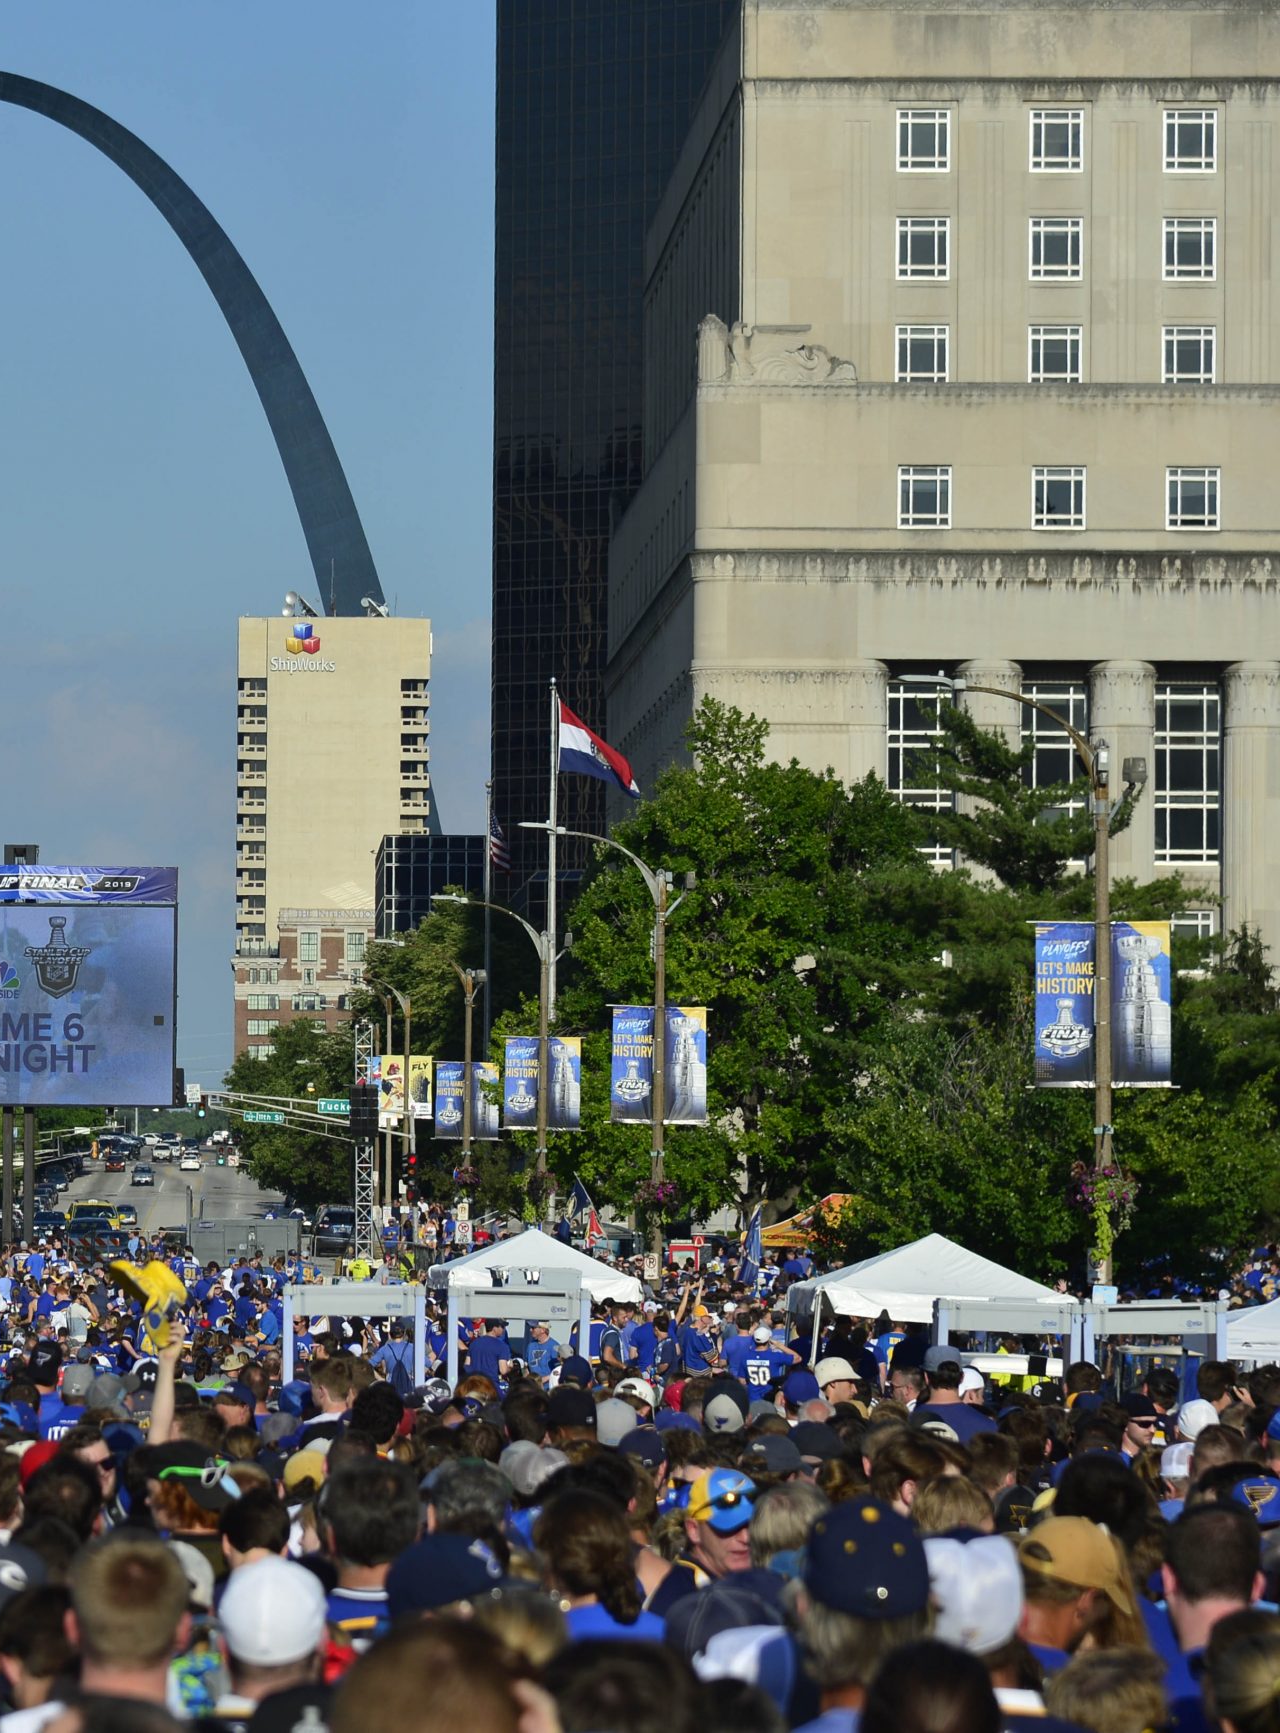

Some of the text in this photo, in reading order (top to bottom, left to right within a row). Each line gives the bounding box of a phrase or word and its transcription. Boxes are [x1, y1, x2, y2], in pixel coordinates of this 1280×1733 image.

[270, 656, 335, 673] ShipWorks
[19, 876, 80, 890] FINAL
[25, 947, 90, 956] STANLEY CUP
[1042, 940, 1088, 956] PLAYOFFS
[32, 956, 82, 964] PLAYOFFS
[1037, 962, 1094, 975] LET'S MAKE
[1036, 978, 1094, 995] HISTORY
[64, 1012, 84, 1041] 6
[617, 1019, 650, 1030] PLAYOFFS
[614, 1034, 653, 1044] LET'S MAKE
[1040, 1030, 1092, 1038] FINAL
[614, 1046, 653, 1058] HISTORY
[412, 1062, 428, 1072] FLY
[506, 1059, 538, 1067] LET'S MAKE
[506, 1068, 538, 1078] HISTORY
[437, 1088, 464, 1096] HISTORY
[747, 1367, 771, 1386] 50
